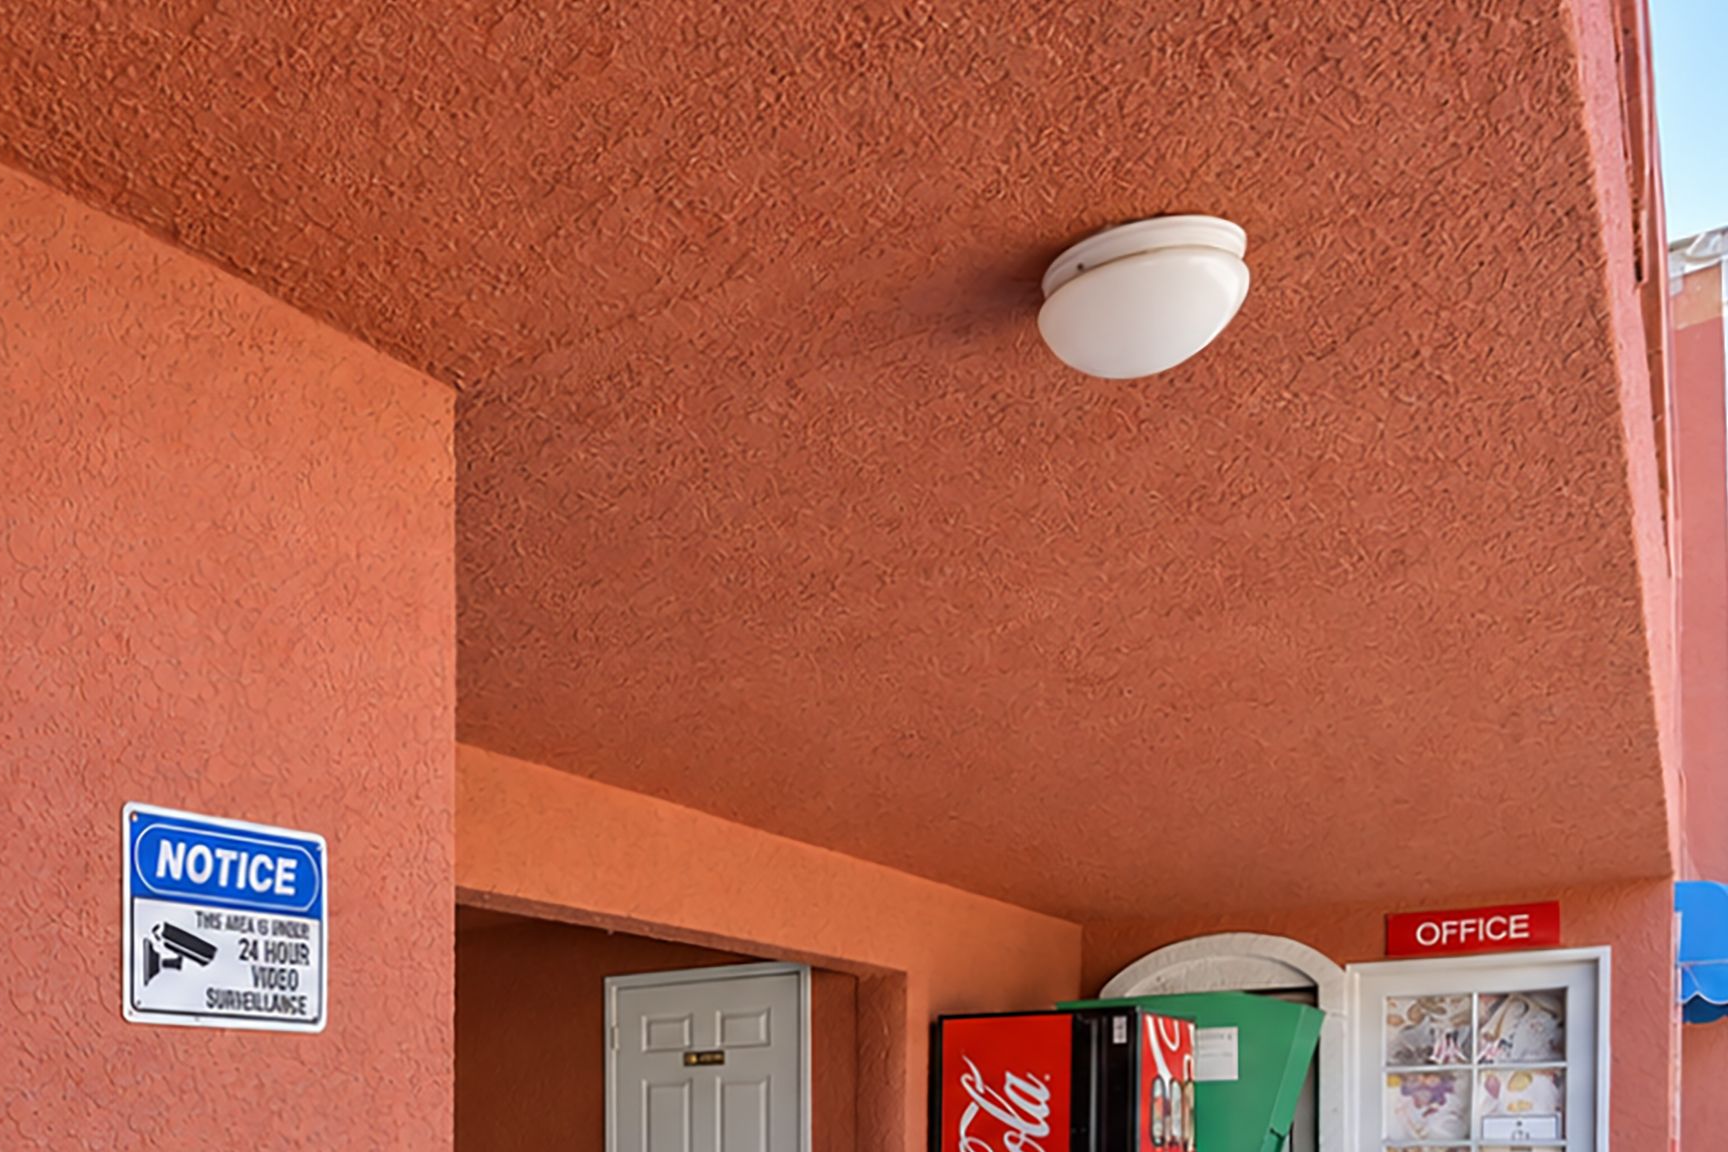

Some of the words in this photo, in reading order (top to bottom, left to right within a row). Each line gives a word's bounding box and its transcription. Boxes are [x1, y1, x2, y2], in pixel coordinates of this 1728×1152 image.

[155, 839, 298, 896] NOTICE
[195, 910, 222, 931] THIS
[225, 914, 255, 934] AREA
[257, 918, 270, 936] IS
[271, 919, 311, 941] UNDER
[1415, 913, 1530, 946] OFFICE
[238, 937, 259, 961] 24
[263, 940, 311, 966] HOUR
[251, 965, 300, 992] VIDEO
[205, 987, 308, 1016] SURVEILLANCE
